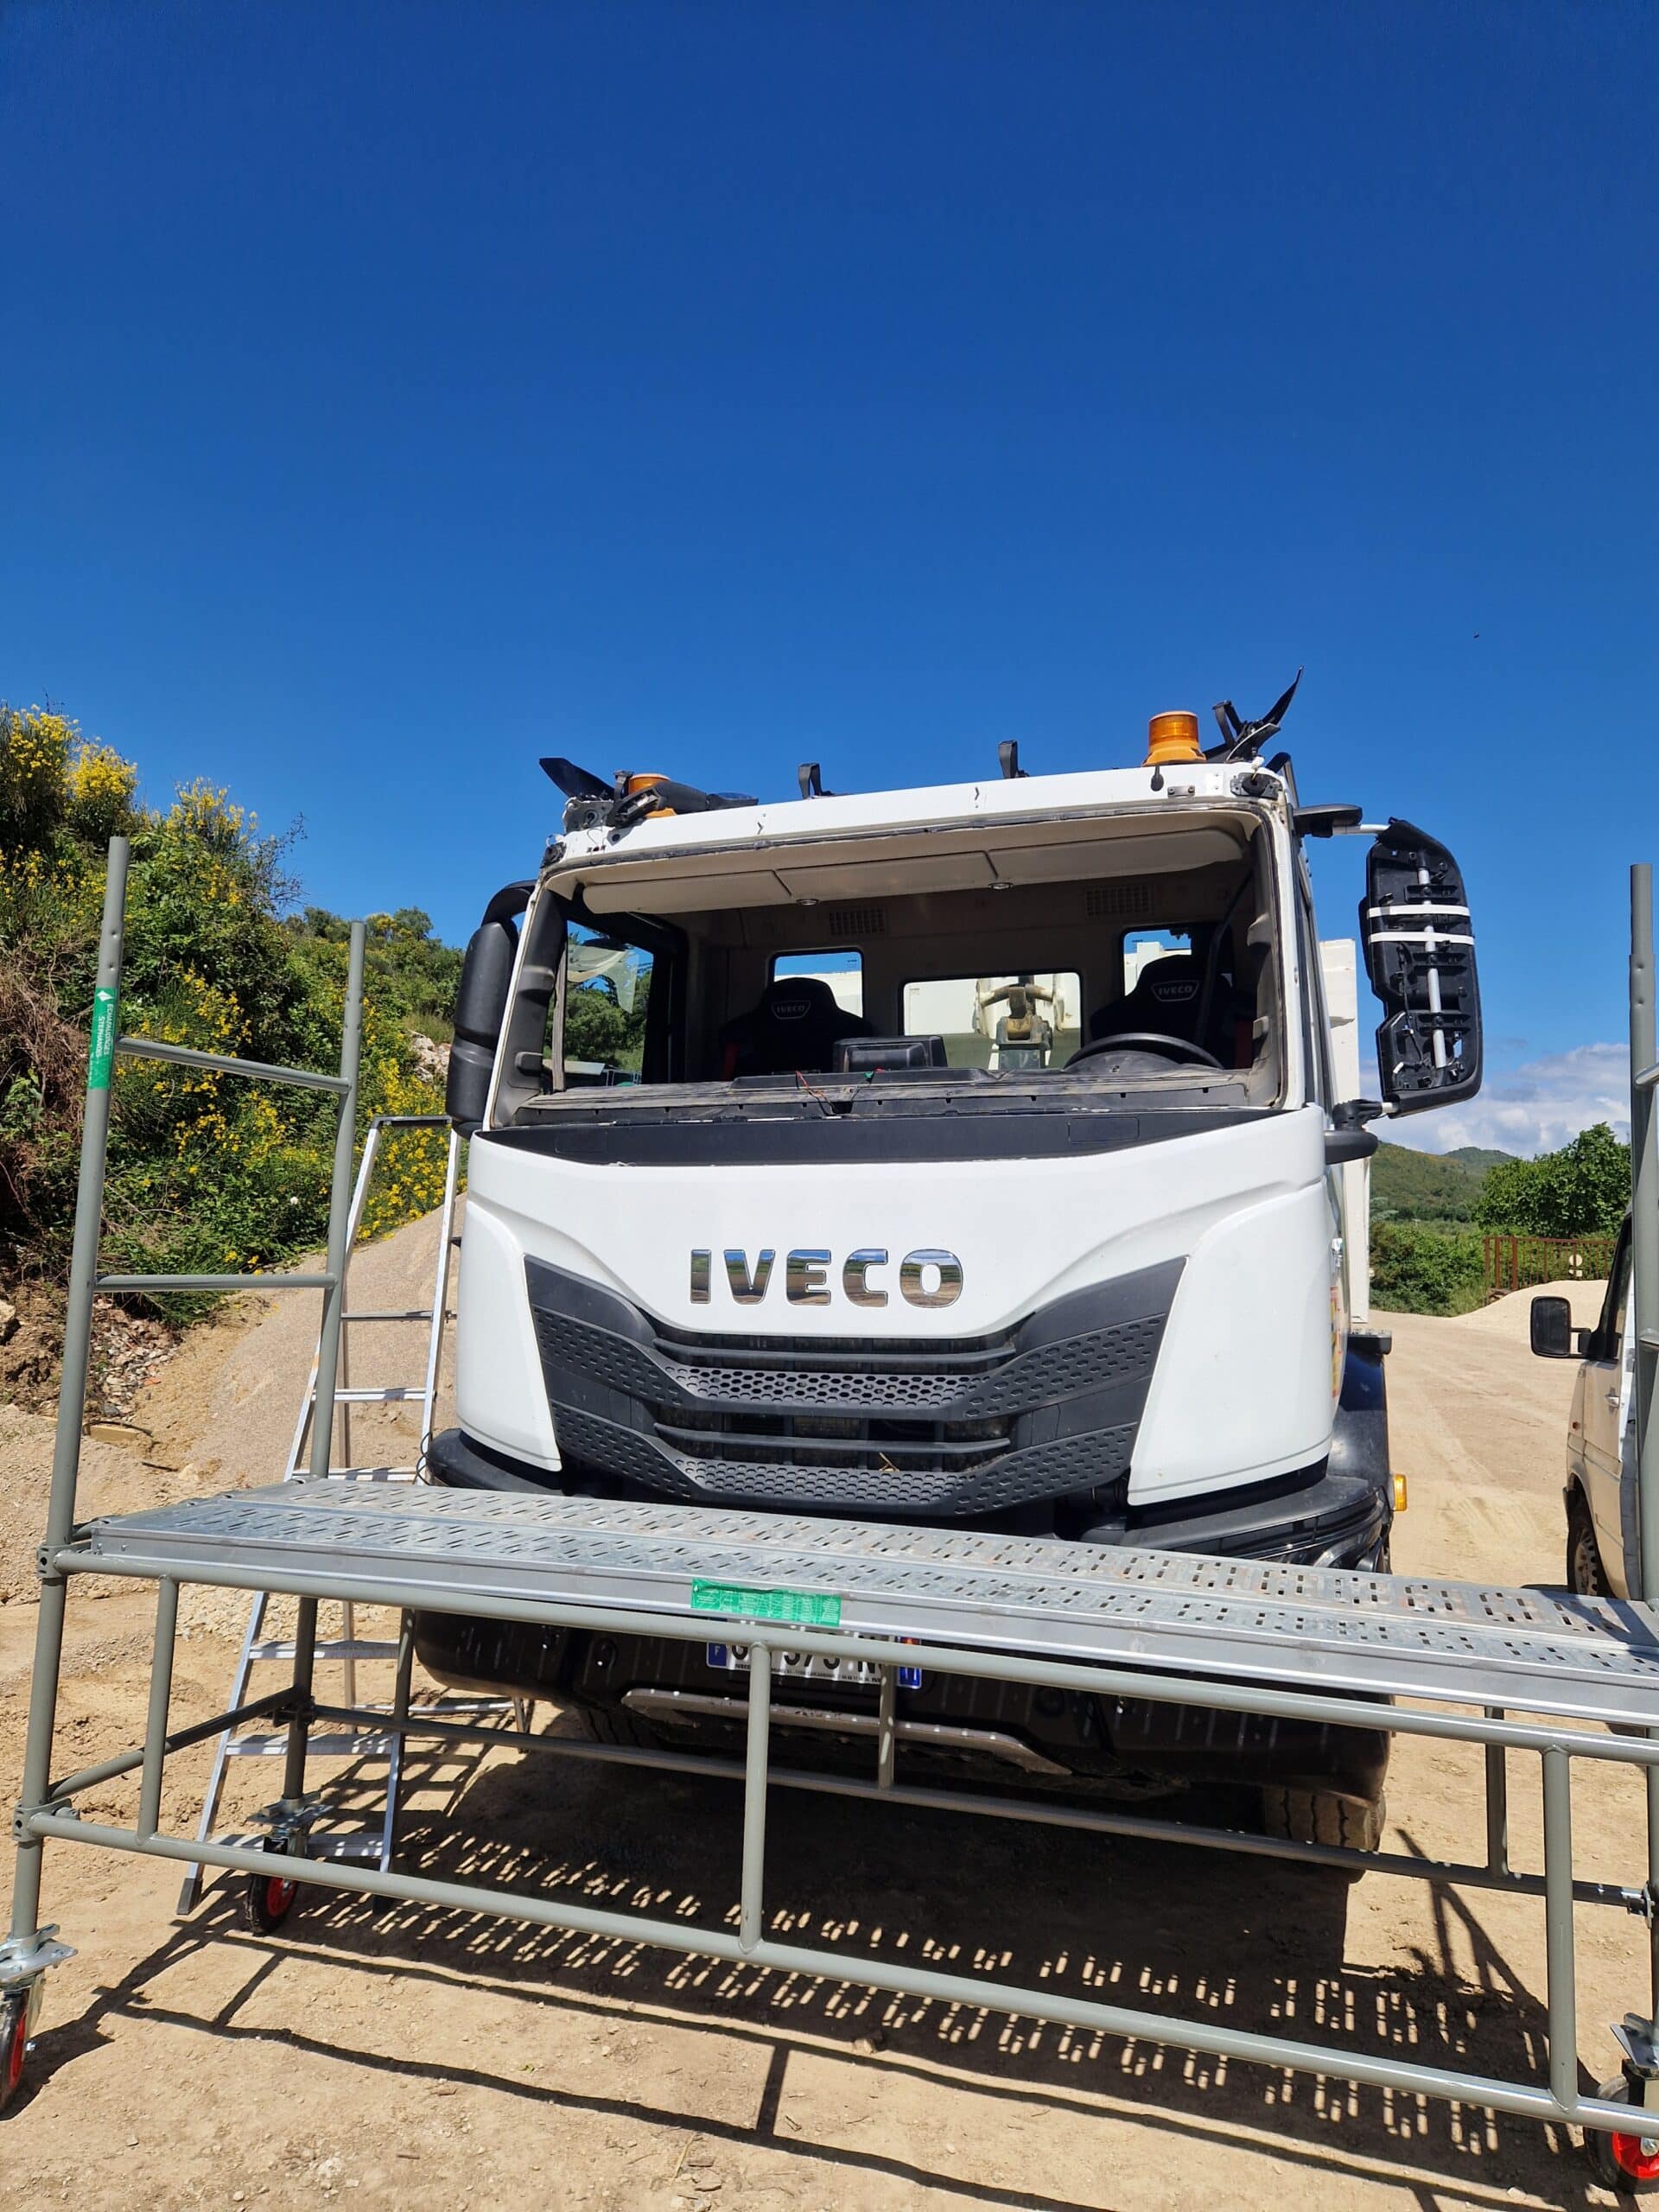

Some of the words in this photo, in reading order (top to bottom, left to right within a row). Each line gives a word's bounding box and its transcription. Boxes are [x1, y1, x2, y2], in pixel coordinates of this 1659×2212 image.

[1159, 985, 1192, 995] IVECO
[777, 1005, 805, 1014] IVECO
[690, 1249, 963, 1308] IVECO
